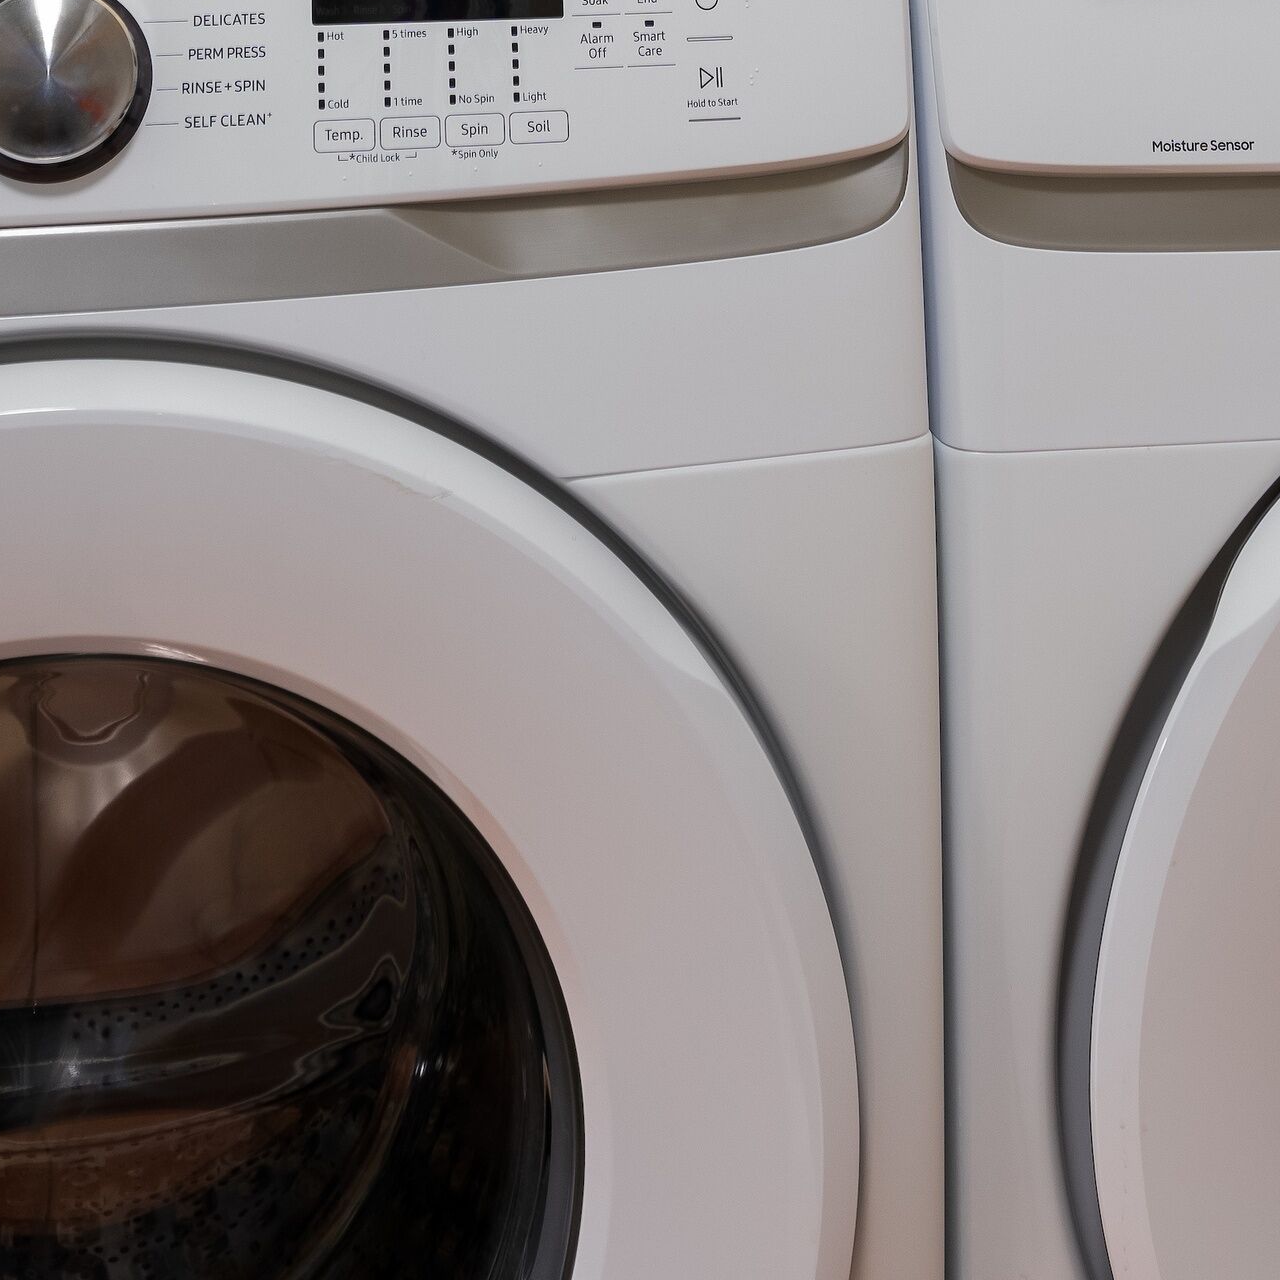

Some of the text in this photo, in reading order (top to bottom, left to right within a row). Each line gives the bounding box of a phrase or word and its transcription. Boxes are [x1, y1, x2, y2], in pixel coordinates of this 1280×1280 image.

[193, 13, 265, 27] DELICATES
[392, 29, 427, 38] 5 times
[457, 27, 479, 37] High
[520, 25, 549, 35] Heavy
[327, 32, 344, 41] Hot
[580, 33, 614, 44] Alarm
[633, 31, 665, 42] Smart
[188, 46, 265, 60] PERM PRESS
[589, 47, 607, 59] Off
[638, 45, 662, 56] Care
[181, 79, 265, 94] RINSE + SPIN
[394, 97, 422, 106] 1 time
[459, 94, 495, 105] No Spin
[523, 92, 547, 103] Light
[687, 97, 738, 108] Hold to Start
[328, 99, 349, 108] Cold
[184, 115, 216, 129] SELF
[528, 120, 550, 133] Soil
[393, 126, 427, 138] Rinse
[461, 123, 488, 136] Spin
[325, 129, 363, 142] Temp.
[1152, 139, 1255, 152] Moisture Sensor
[381, 153, 400, 162] Lock
[479, 148, 498, 159] Only
